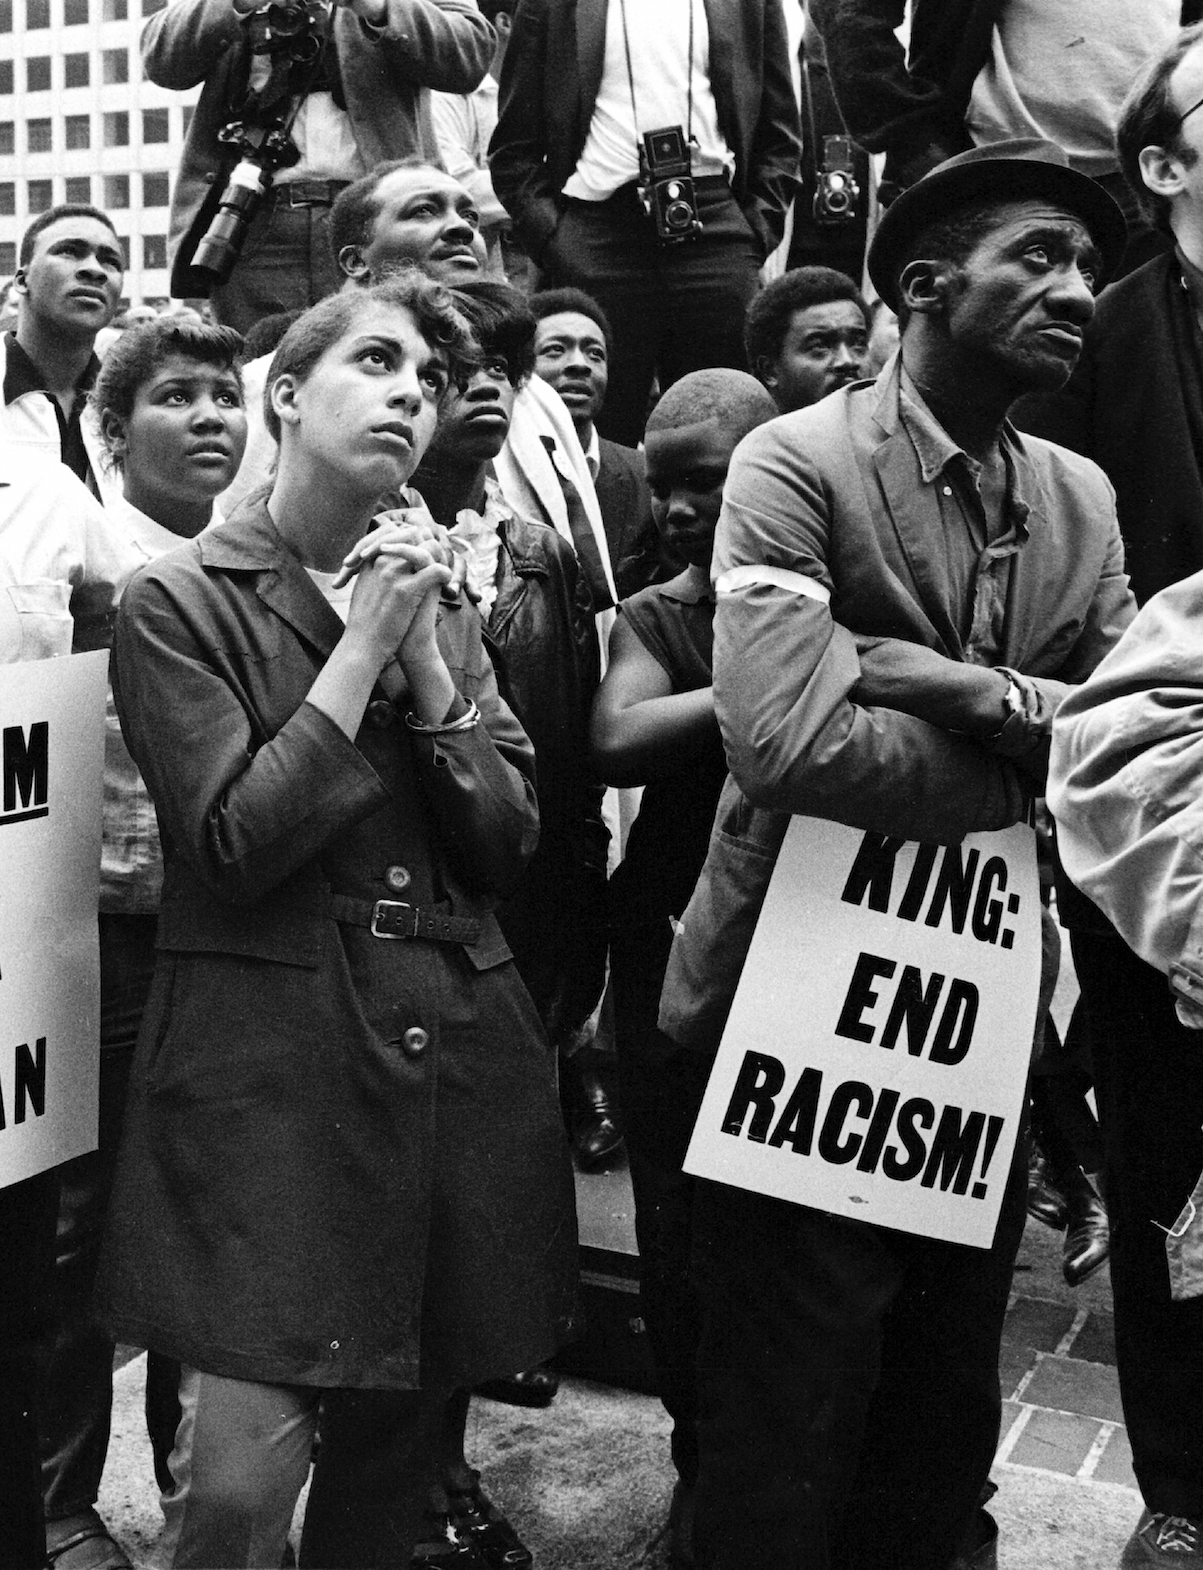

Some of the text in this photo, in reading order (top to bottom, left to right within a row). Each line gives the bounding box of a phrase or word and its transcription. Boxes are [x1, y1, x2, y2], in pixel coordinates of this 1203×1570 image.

[840, 830, 1021, 950] KING:
[834, 951, 980, 1066] END
[720, 1049, 1005, 1200] RACISM!
